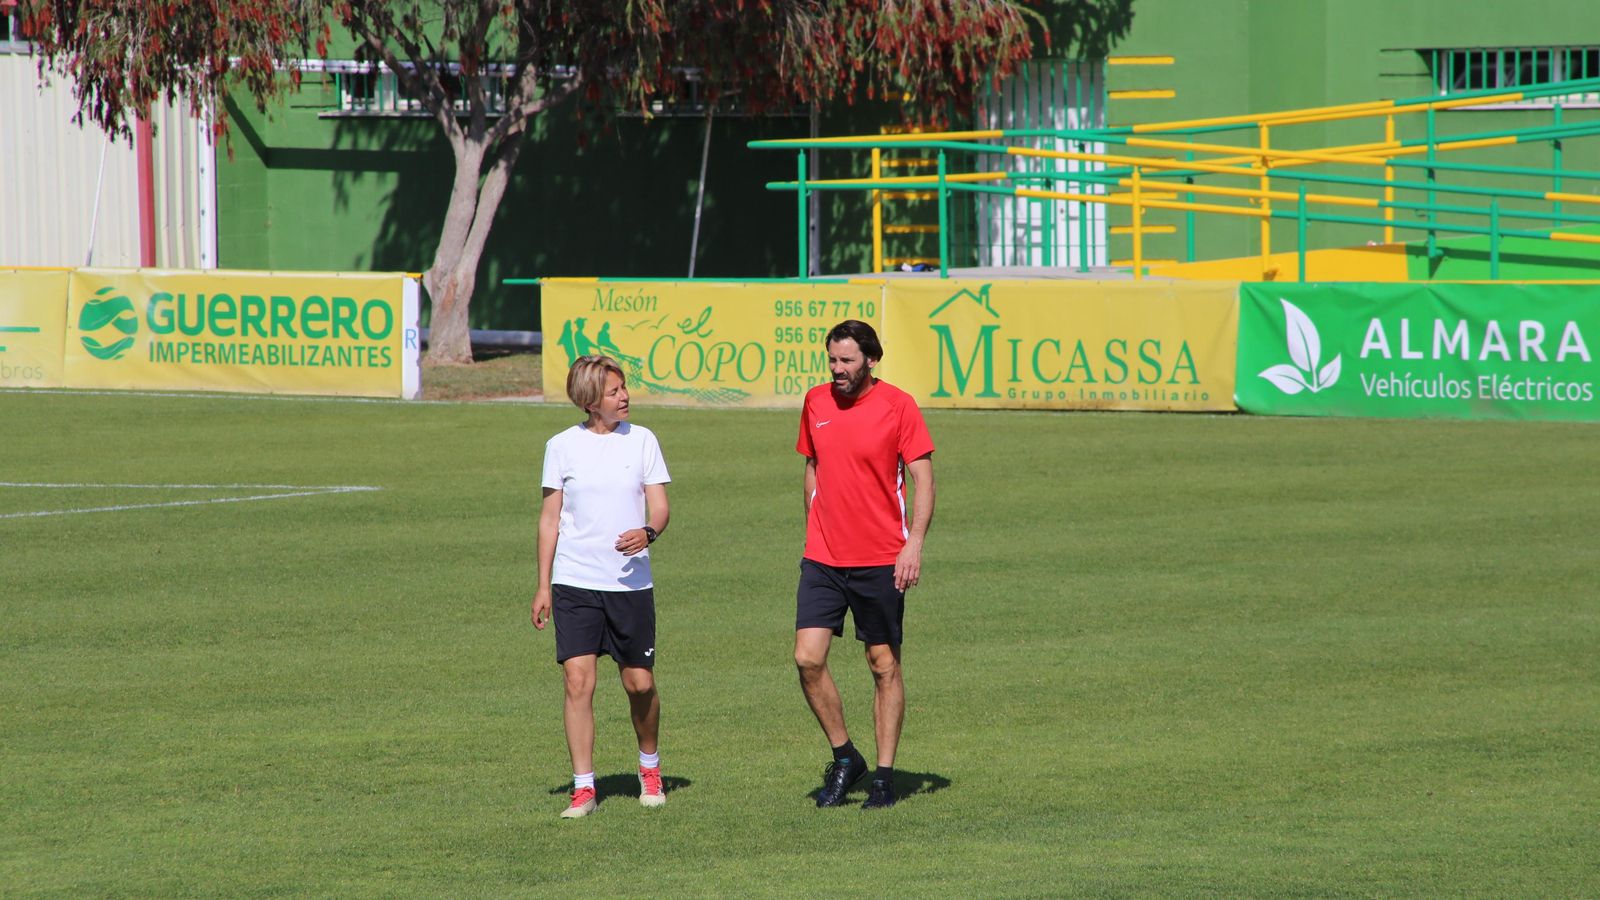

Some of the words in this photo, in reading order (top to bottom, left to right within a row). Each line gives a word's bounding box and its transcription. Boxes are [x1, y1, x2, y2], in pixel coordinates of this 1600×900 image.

[592, 288, 658, 312] Mesón
[774, 300, 804, 318] 956
[808, 300, 827, 318] 67
[832, 300, 851, 318] 77
[857, 301, 875, 318] 10
[677, 306, 714, 338] el
[774, 327, 804, 344] 956
[808, 327, 827, 344] 67
[1360, 318, 1592, 363] ALMARA
[148, 341, 393, 368] IMPERMEABILIZANTES
[648, 334, 766, 383] COPO
[774, 350, 827, 373] PALM
[929, 325, 1201, 398] MICASSA
[774, 376, 802, 396] LOS
[1008, 387, 1066, 402] Grupo
[1080, 388, 1209, 402] Inmobiliario
[1360, 372, 1472, 399] Vehículos
[1478, 375, 1593, 401] Eléctricos
